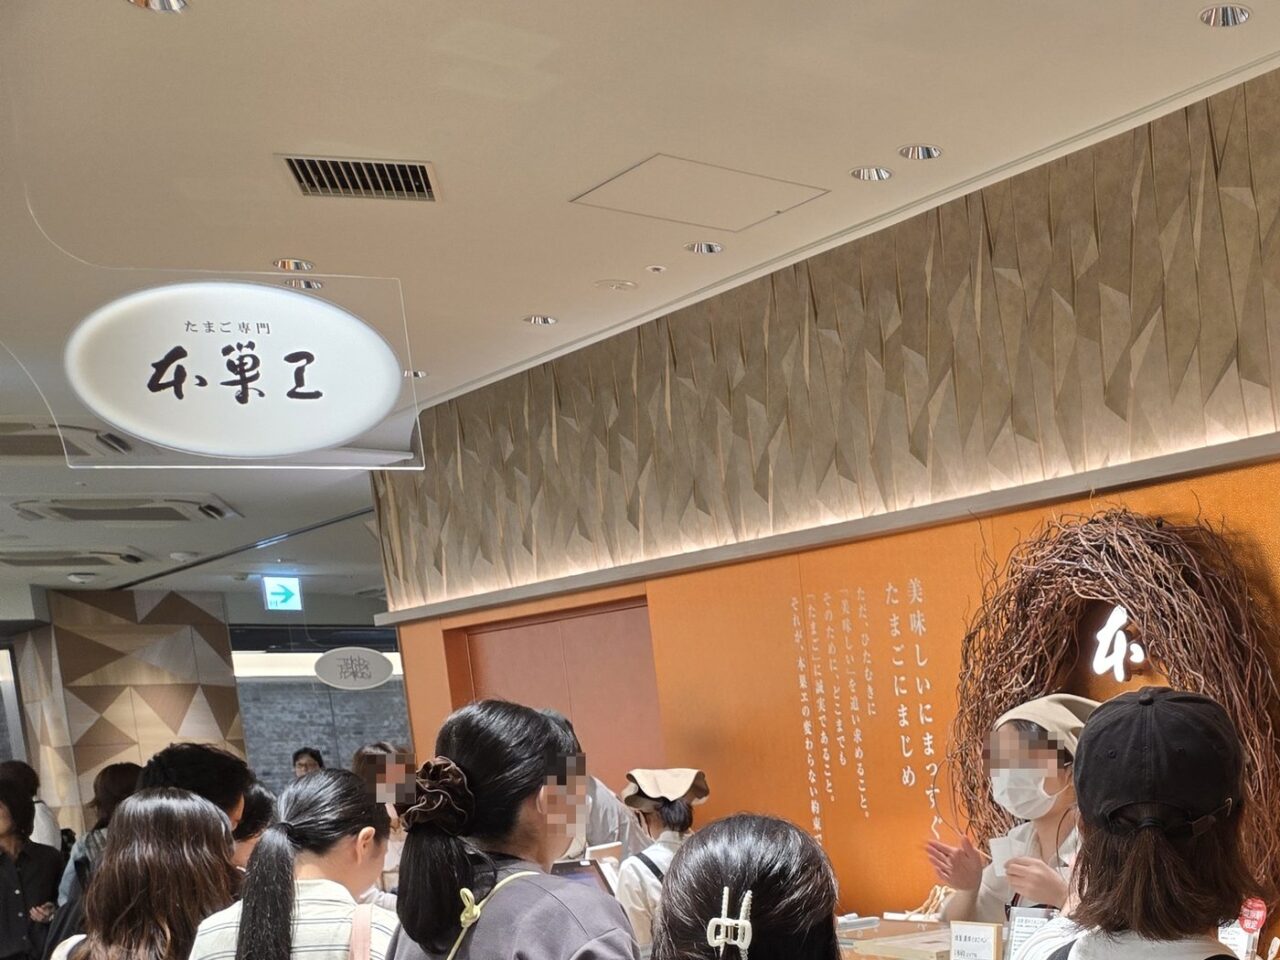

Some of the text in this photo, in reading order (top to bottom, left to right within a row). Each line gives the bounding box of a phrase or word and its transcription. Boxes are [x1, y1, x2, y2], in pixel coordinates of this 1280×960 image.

[184, 320, 271, 335] たまご専門
[823, 592, 846, 765] そのために、どこまでも
[857, 586, 877, 715] ただ、ひたむきに
[885, 582, 916, 787] たまごにまじめ
[907, 577, 943, 840] 美味しいにまっすぐ
